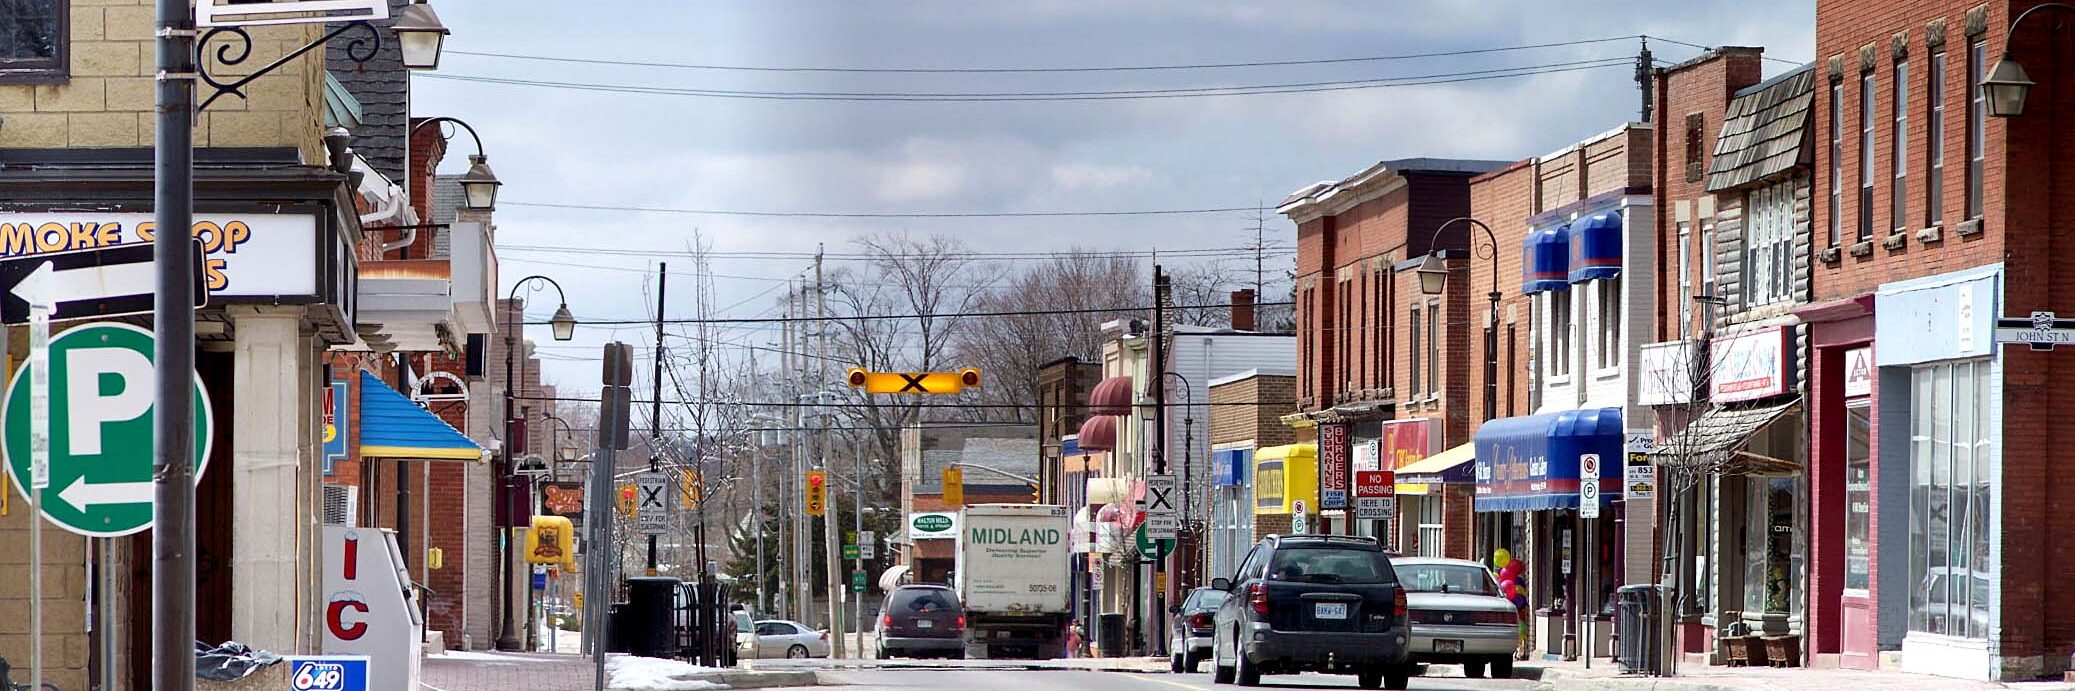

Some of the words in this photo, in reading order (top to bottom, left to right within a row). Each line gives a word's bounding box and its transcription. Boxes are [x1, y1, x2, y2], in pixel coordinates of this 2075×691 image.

[136, 221, 250, 254] SOP
[2016, 331, 2044, 341] JOHN
[2047, 332, 2059, 341] ST
[2062, 332, 2070, 342] N
[66, 348, 154, 456] P
[1324, 428, 1333, 489] SUBMARINES
[1334, 427, 1345, 489] BURGERS
[1369, 474, 1382, 484] NO
[1358, 485, 1393, 495] PASSING
[1361, 499, 1378, 507] HERE
[1382, 499, 1390, 507] TO
[1360, 508, 1393, 517] CROSSING
[972, 528, 1060, 545] MIDLAND
[294, 664, 341, 690] 649
